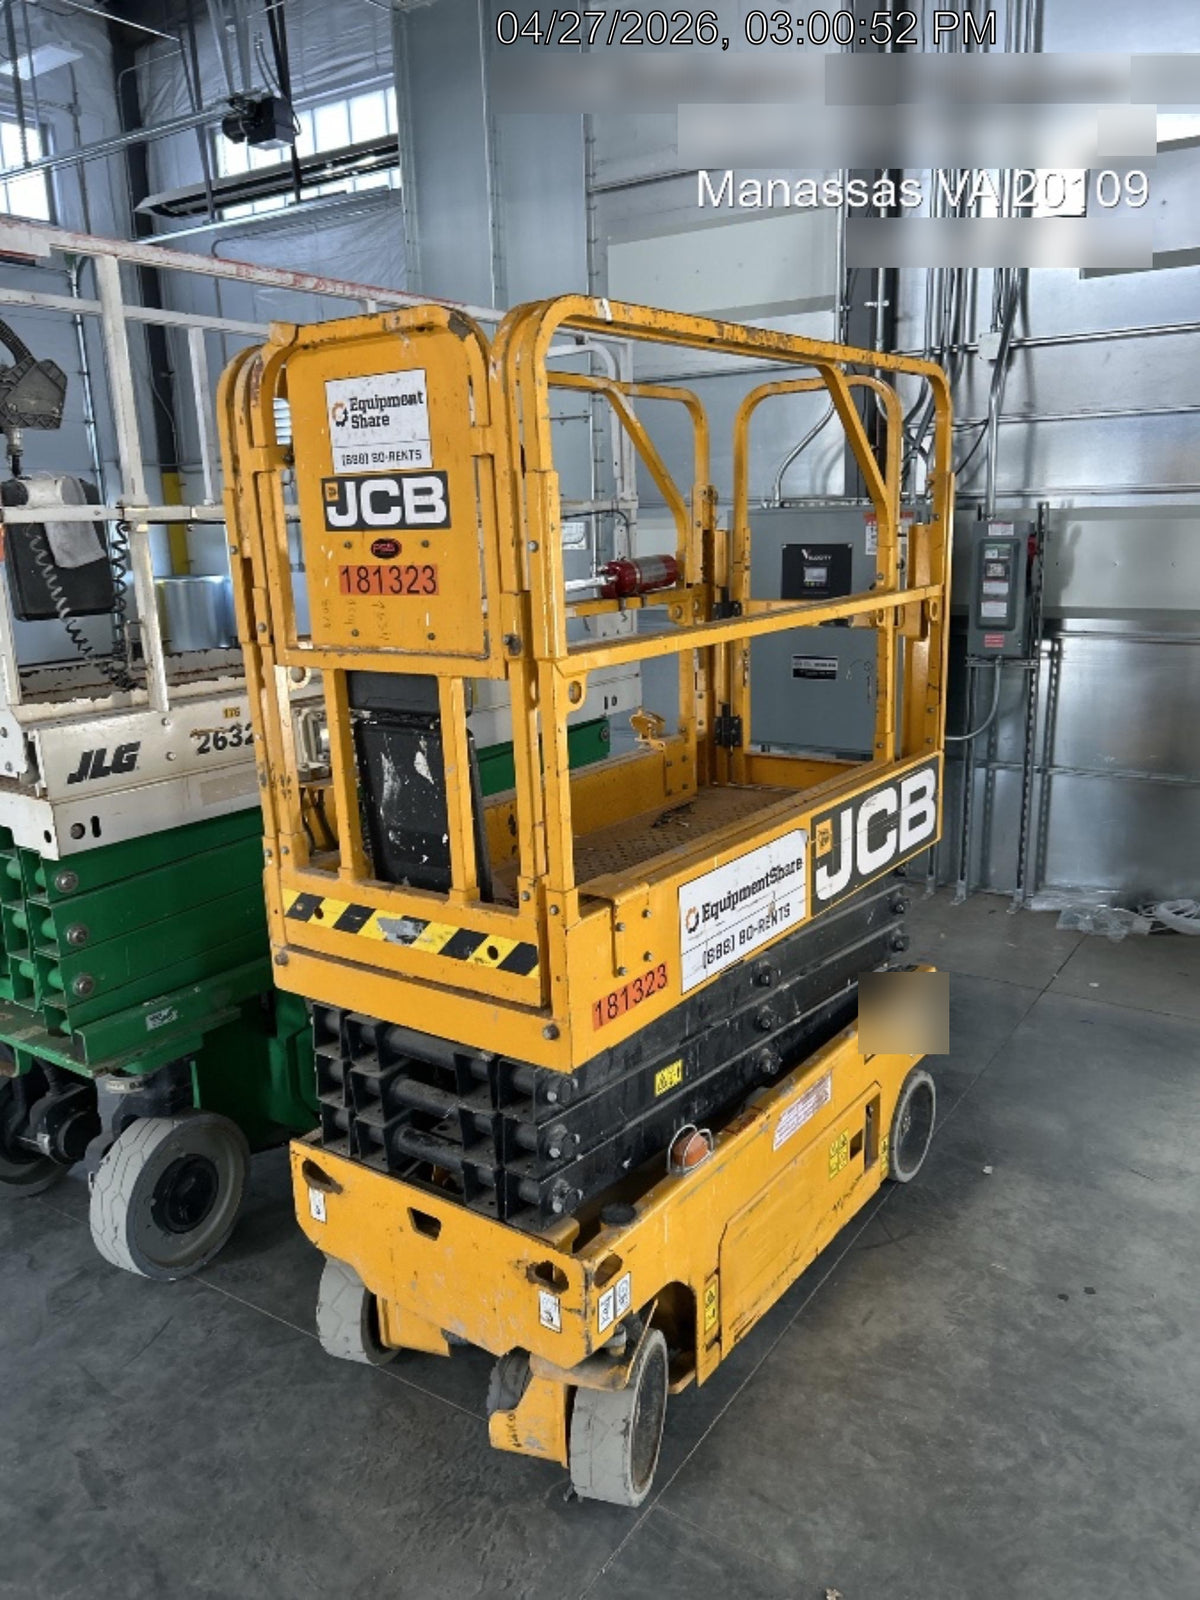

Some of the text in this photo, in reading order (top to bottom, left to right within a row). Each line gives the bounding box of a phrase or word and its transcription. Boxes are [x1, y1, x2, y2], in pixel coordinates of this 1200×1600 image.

[349, 390, 424, 414] Equipment
[351, 413, 390, 429] Share
[326, 476, 447, 527] JCB
[342, 565, 436, 594] 181323
[67, 741, 141, 784] JLG
[816, 768, 936, 900] JCB
[702, 858, 803, 924] EquipmentShare
[595, 963, 667, 1027] 181323
